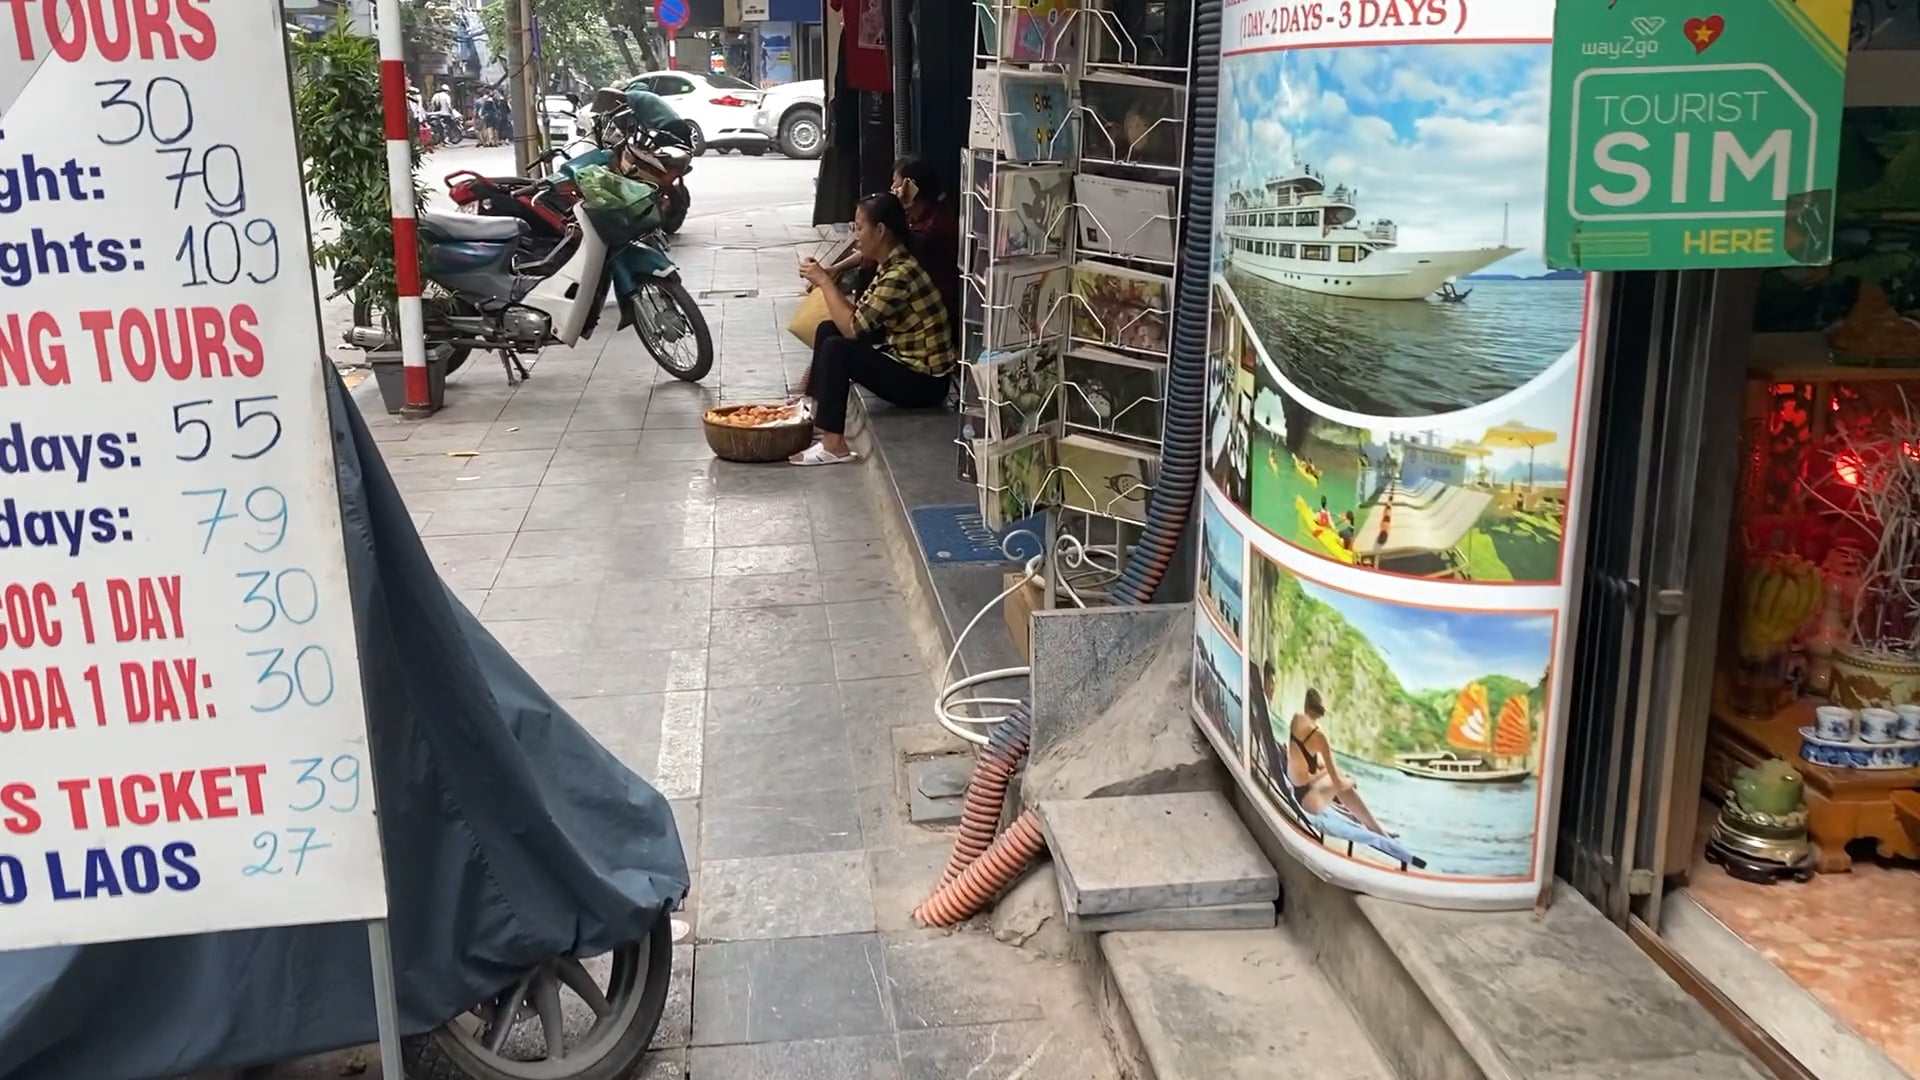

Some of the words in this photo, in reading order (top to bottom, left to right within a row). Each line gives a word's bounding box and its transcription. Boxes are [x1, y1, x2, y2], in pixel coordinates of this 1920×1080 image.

[9, 0, 217, 62] TOURS
[1280, 3, 1323, 33] DAYS
[1582, 36, 1659, 60] way2go
[95, 77, 193, 145] 30
[1594, 90, 1769, 127] TOURIST
[1589, 129, 1793, 207] SIM
[0, 228, 145, 287] ghts:
[175, 218, 280, 287] 109
[1682, 228, 1775, 256] HERE
[80, 304, 265, 384] TOURS
[0, 422, 142, 483] days:
[172, 395, 282, 461] 55
[0, 498, 133, 557] days:
[181, 486, 289, 555] 79
[72, 582, 96, 644] 1
[106, 575, 185, 643] DAY
[235, 568, 319, 633] 30
[84, 665, 107, 726] 1
[120, 658, 217, 725] DAY:
[245, 645, 335, 713] 30
[58, 764, 267, 831] TICKET
[288, 754, 360, 812] 39
[45, 842, 201, 902] LAOS
[241, 826, 333, 876] 27
